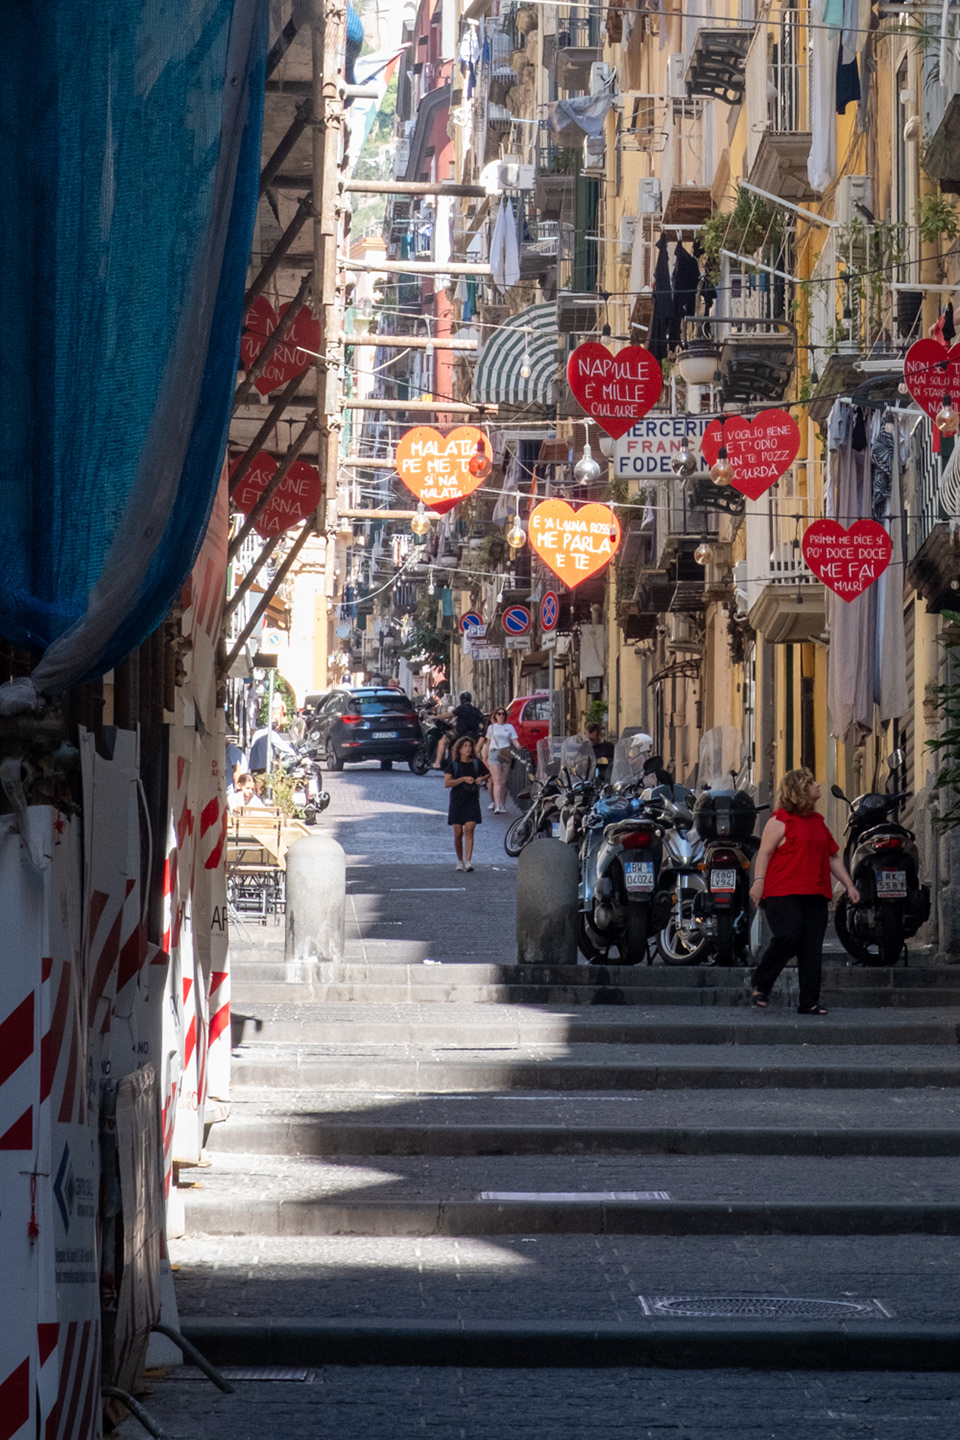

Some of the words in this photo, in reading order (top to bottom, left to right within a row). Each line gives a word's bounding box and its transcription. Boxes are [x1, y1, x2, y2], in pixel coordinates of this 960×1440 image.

[578, 358, 649, 380] NAPULE
[603, 380, 645, 402] MILLE
[591, 402, 639, 418] CULURE
[727, 426, 763, 440] VOGLIO
[767, 425, 791, 436] BENE
[745, 454, 757, 463] TE
[762, 450, 789, 462] POZZ
[438, 475, 458, 486] NA
[242, 488, 303, 516] ETRNA
[537, 531, 558, 548] ME
[563, 533, 611, 554] PARLA
[839, 536, 851, 544] ME
[853, 534, 873, 545] DICE
[570, 553, 590, 569] TE
[826, 547, 854, 559] DOCE
[859, 548, 886, 559] DOCE
[820, 562, 843, 578] ME
[848, 560, 874, 578] FAI
